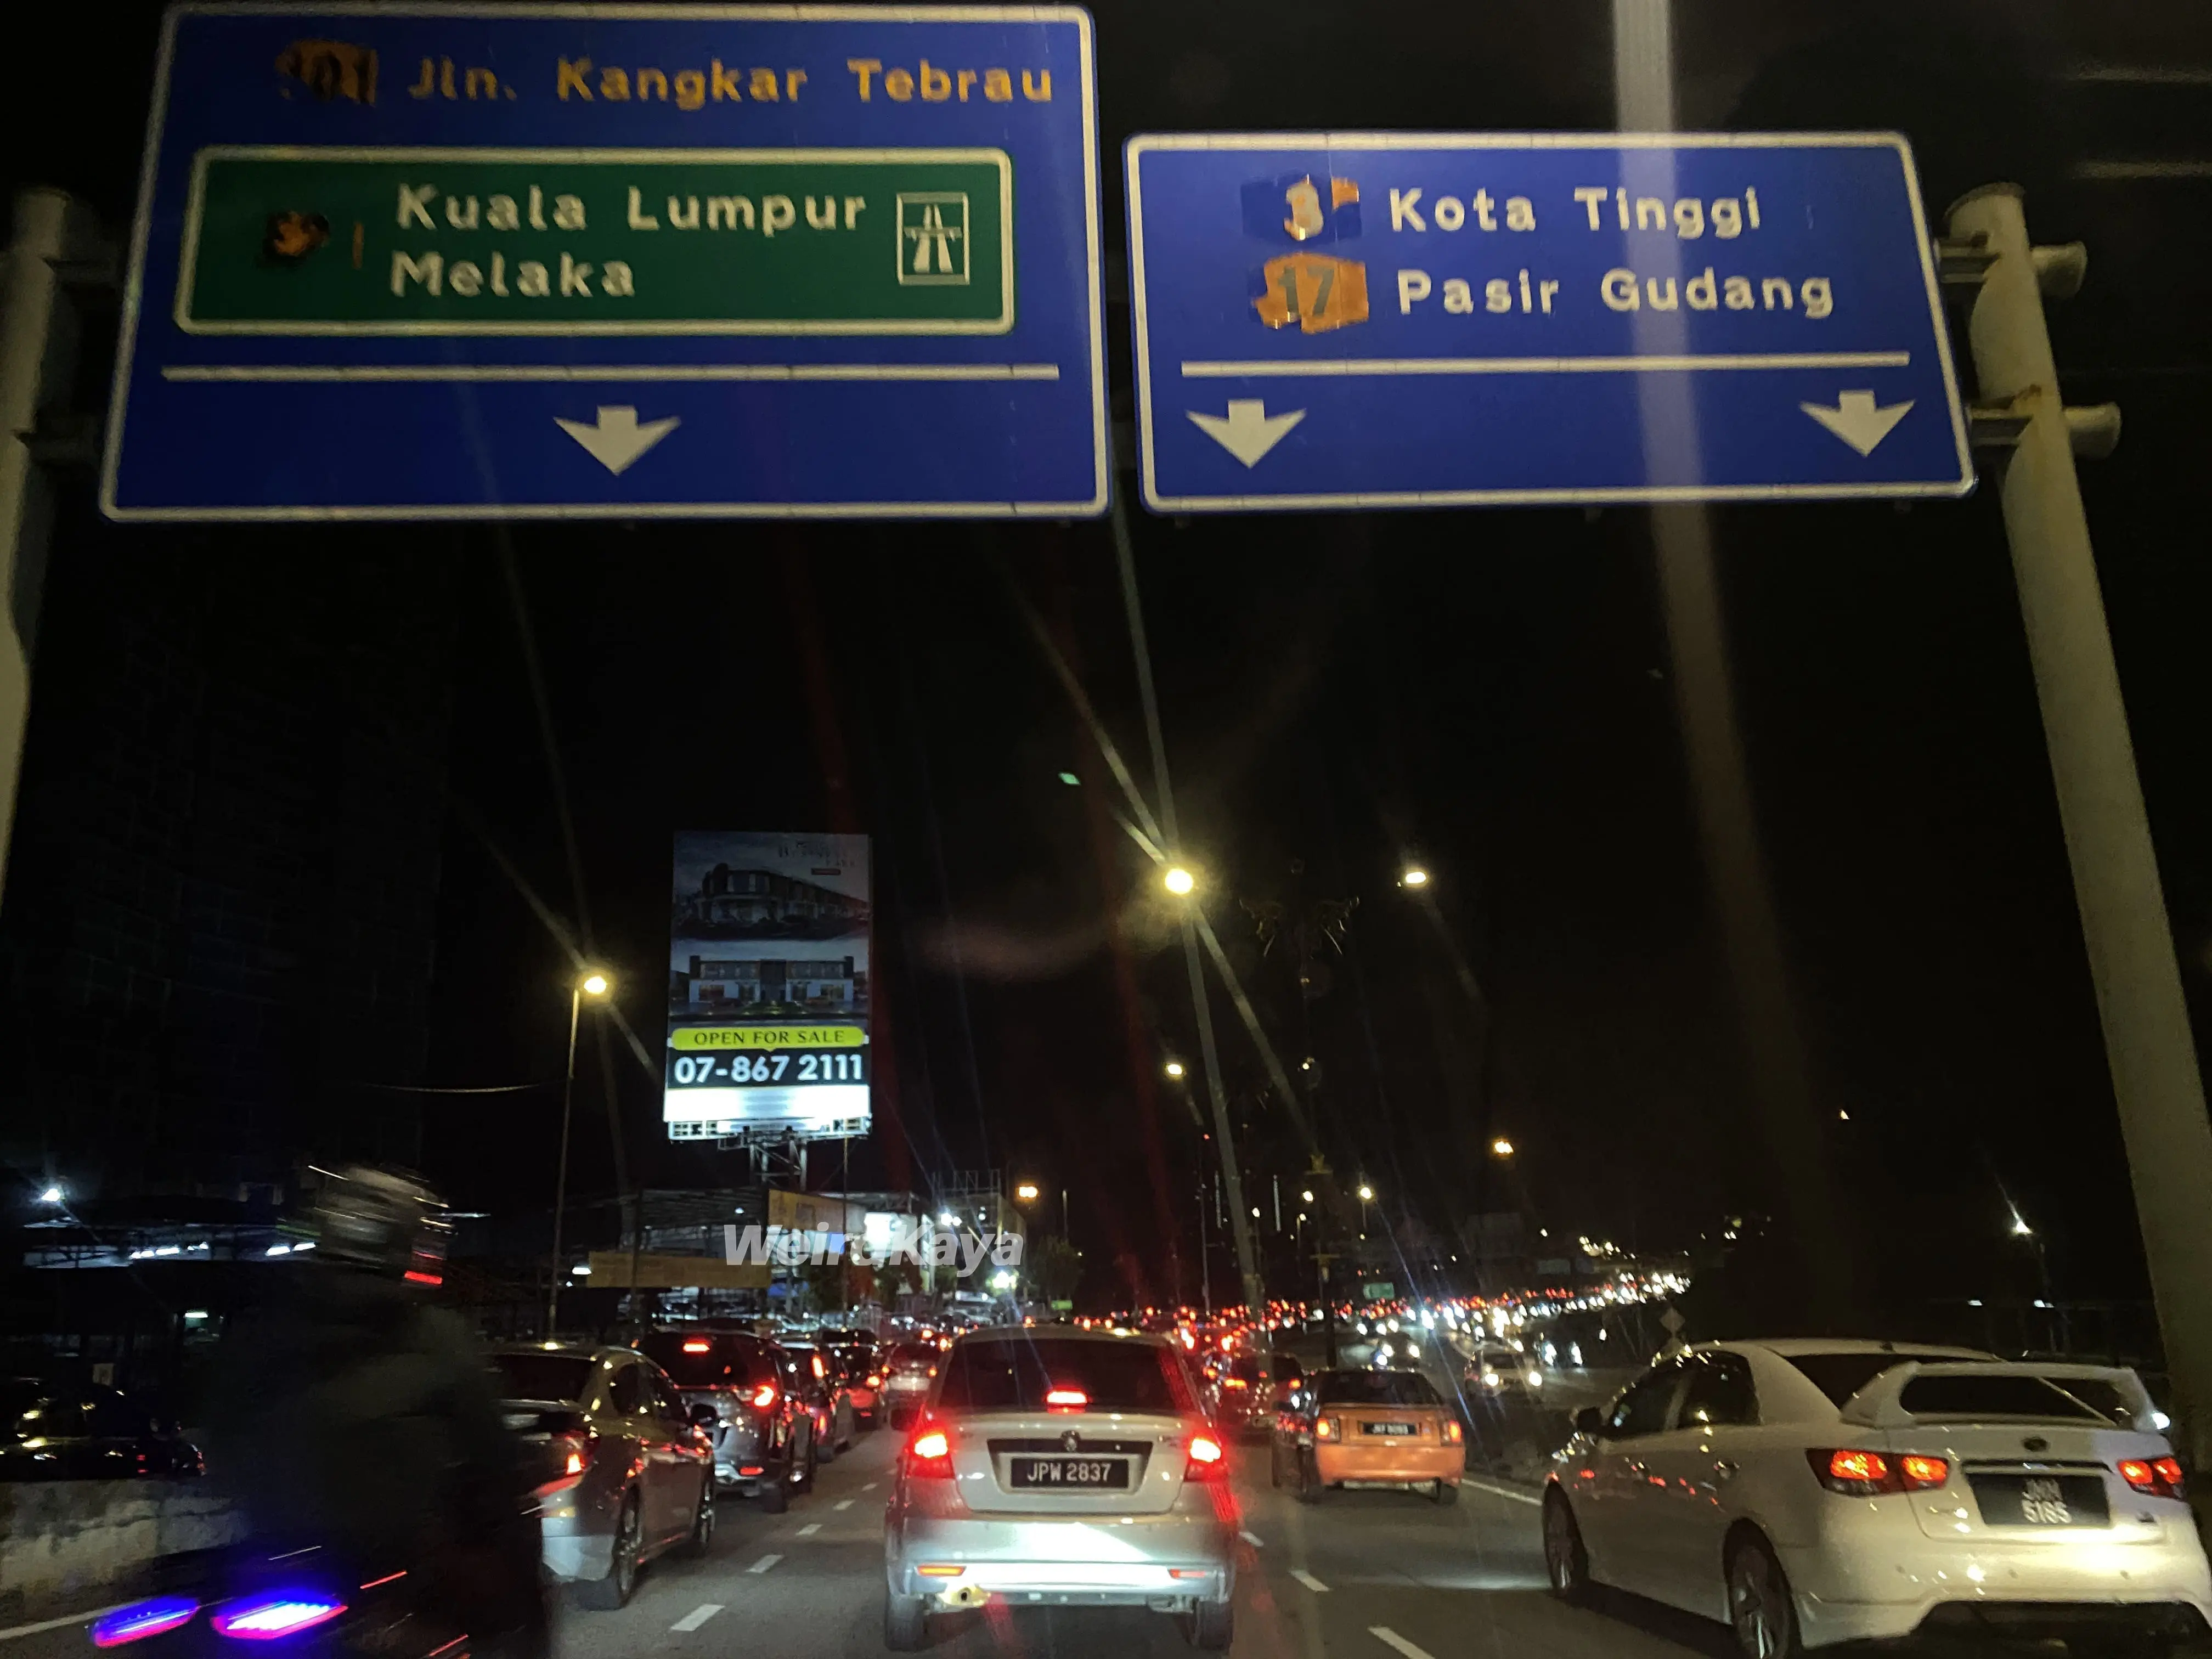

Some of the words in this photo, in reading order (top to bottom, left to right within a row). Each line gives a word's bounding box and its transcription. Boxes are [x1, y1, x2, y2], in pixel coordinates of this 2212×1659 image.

[407, 57, 518, 101] Jln.
[556, 54, 808, 111] Kangkar
[847, 58, 1052, 103] Tebrau
[396, 183, 588, 231] Kuala
[627, 185, 867, 238] Lumpur
[1389, 187, 1536, 232] Kota
[1573, 185, 1760, 240] Tinggi
[388, 250, 636, 298] Melaka
[1278, 265, 1335, 318] 17
[1397, 268, 1559, 315] Pasir
[1600, 266, 1834, 319] Gudang
[693, 1031, 745, 1046] OPEN
[753, 1030, 789, 1044] FOR
[797, 1030, 845, 1043] SALE
[674, 1054, 790, 1084] 07-867
[797, 1053, 863, 1081] 2111
[1026, 1462, 1062, 1481] JPW
[1066, 1462, 1112, 1481] 2837
